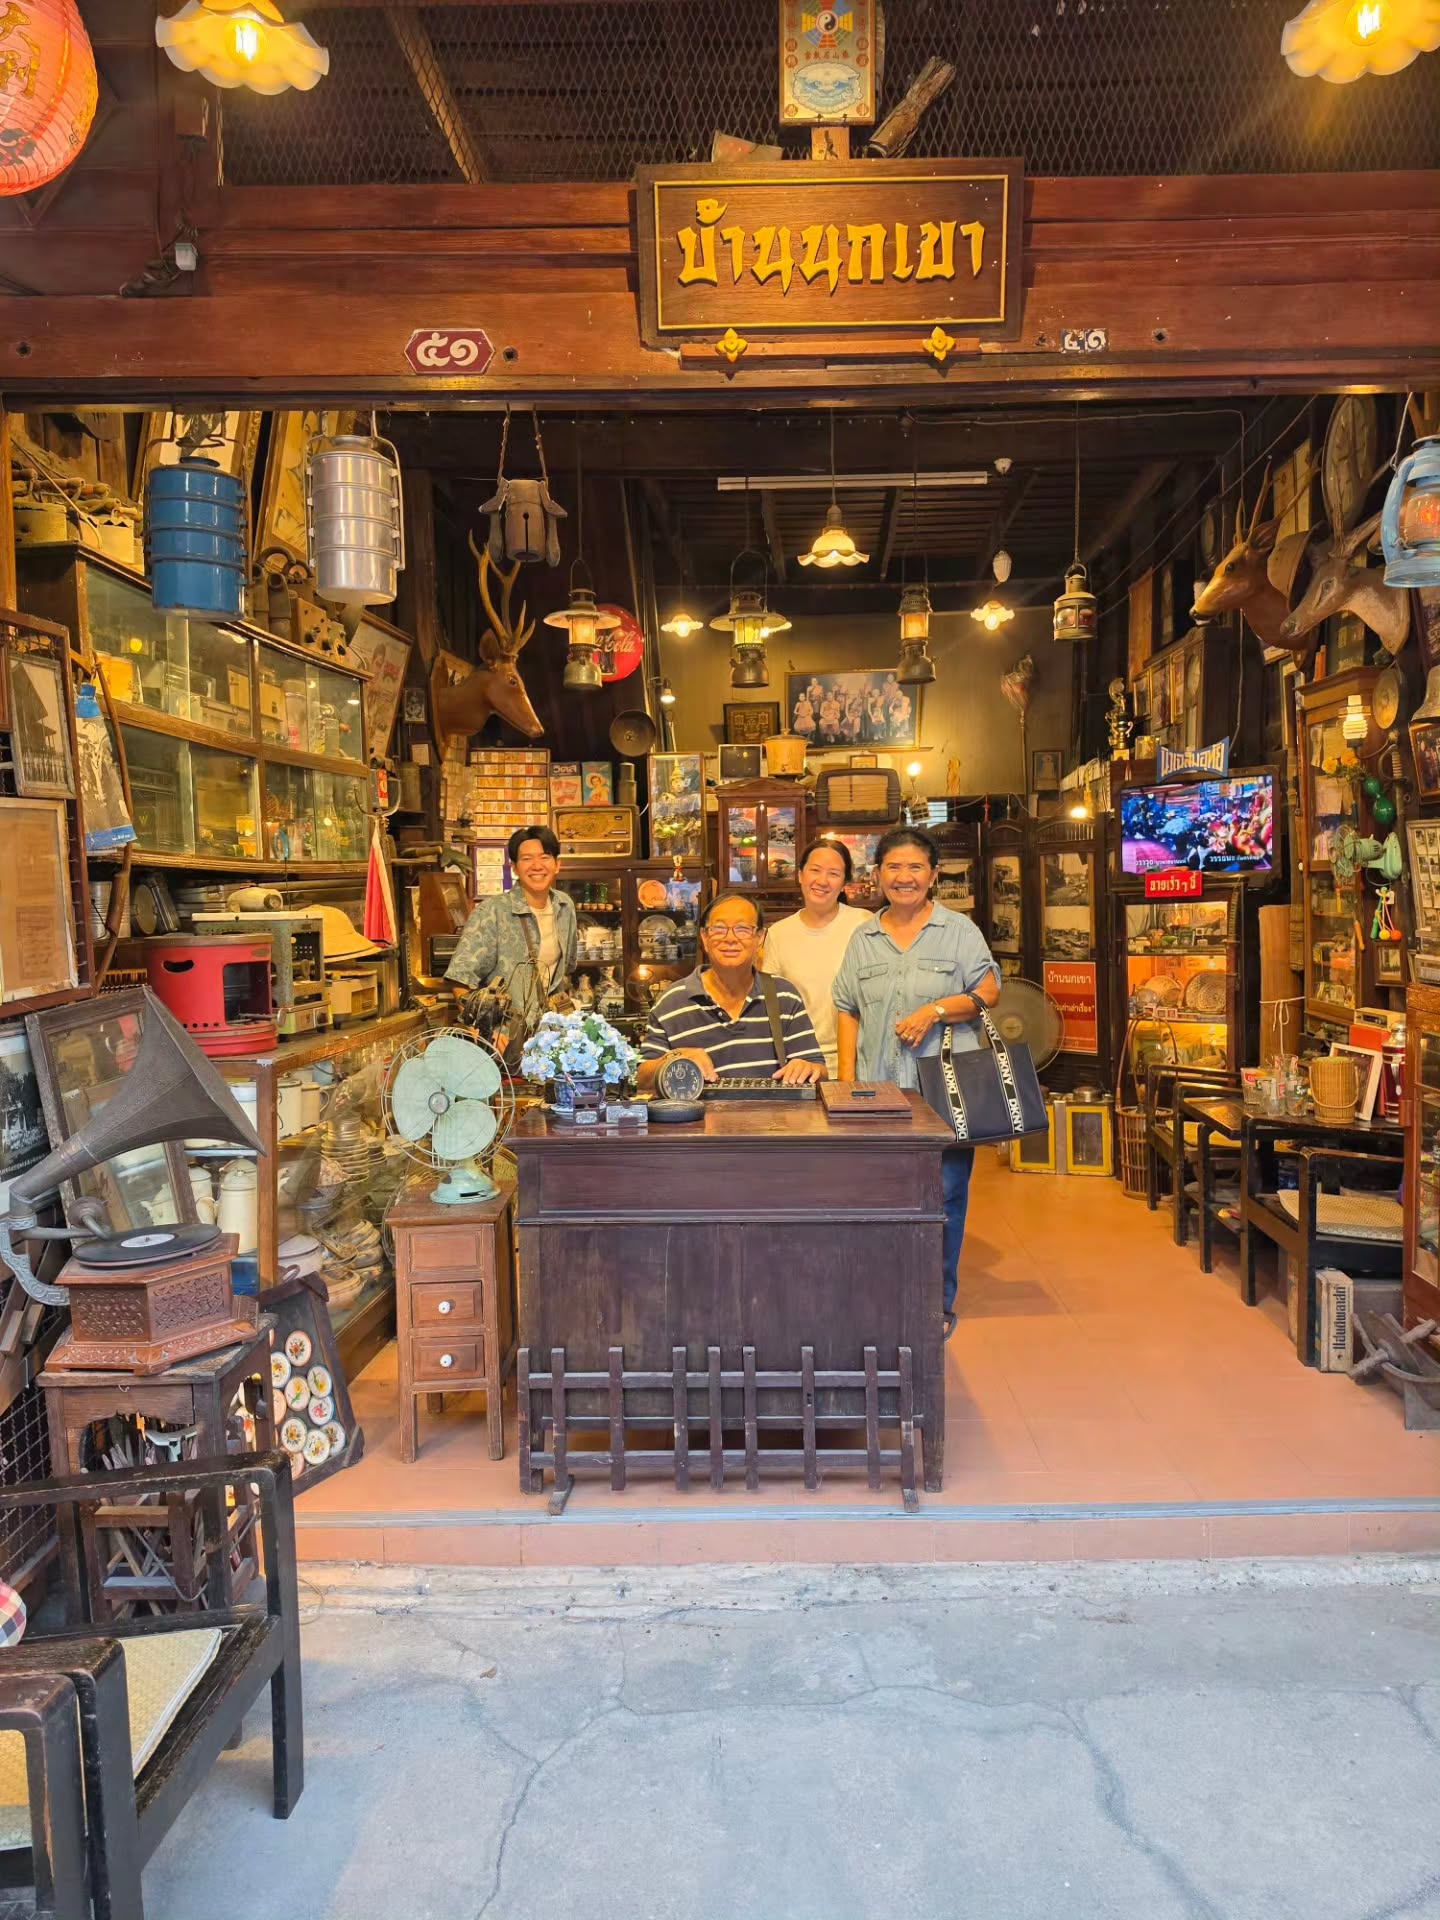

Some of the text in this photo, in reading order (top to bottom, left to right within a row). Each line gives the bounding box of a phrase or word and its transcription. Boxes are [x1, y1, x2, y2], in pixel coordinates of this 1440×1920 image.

[677, 198, 985, 297] บ้านนกเขา
[416, 332, 479, 367] ๕๑
[1048, 970, 1092, 984] บ้านนกเขา
[942, 1026, 951, 1049] DKN
[943, 1062, 958, 1094] DKNY
[997, 1052, 1013, 1085] DKNY
[952, 1107, 967, 1139] DKNY
[1008, 1099, 1023, 1132] DKNY
